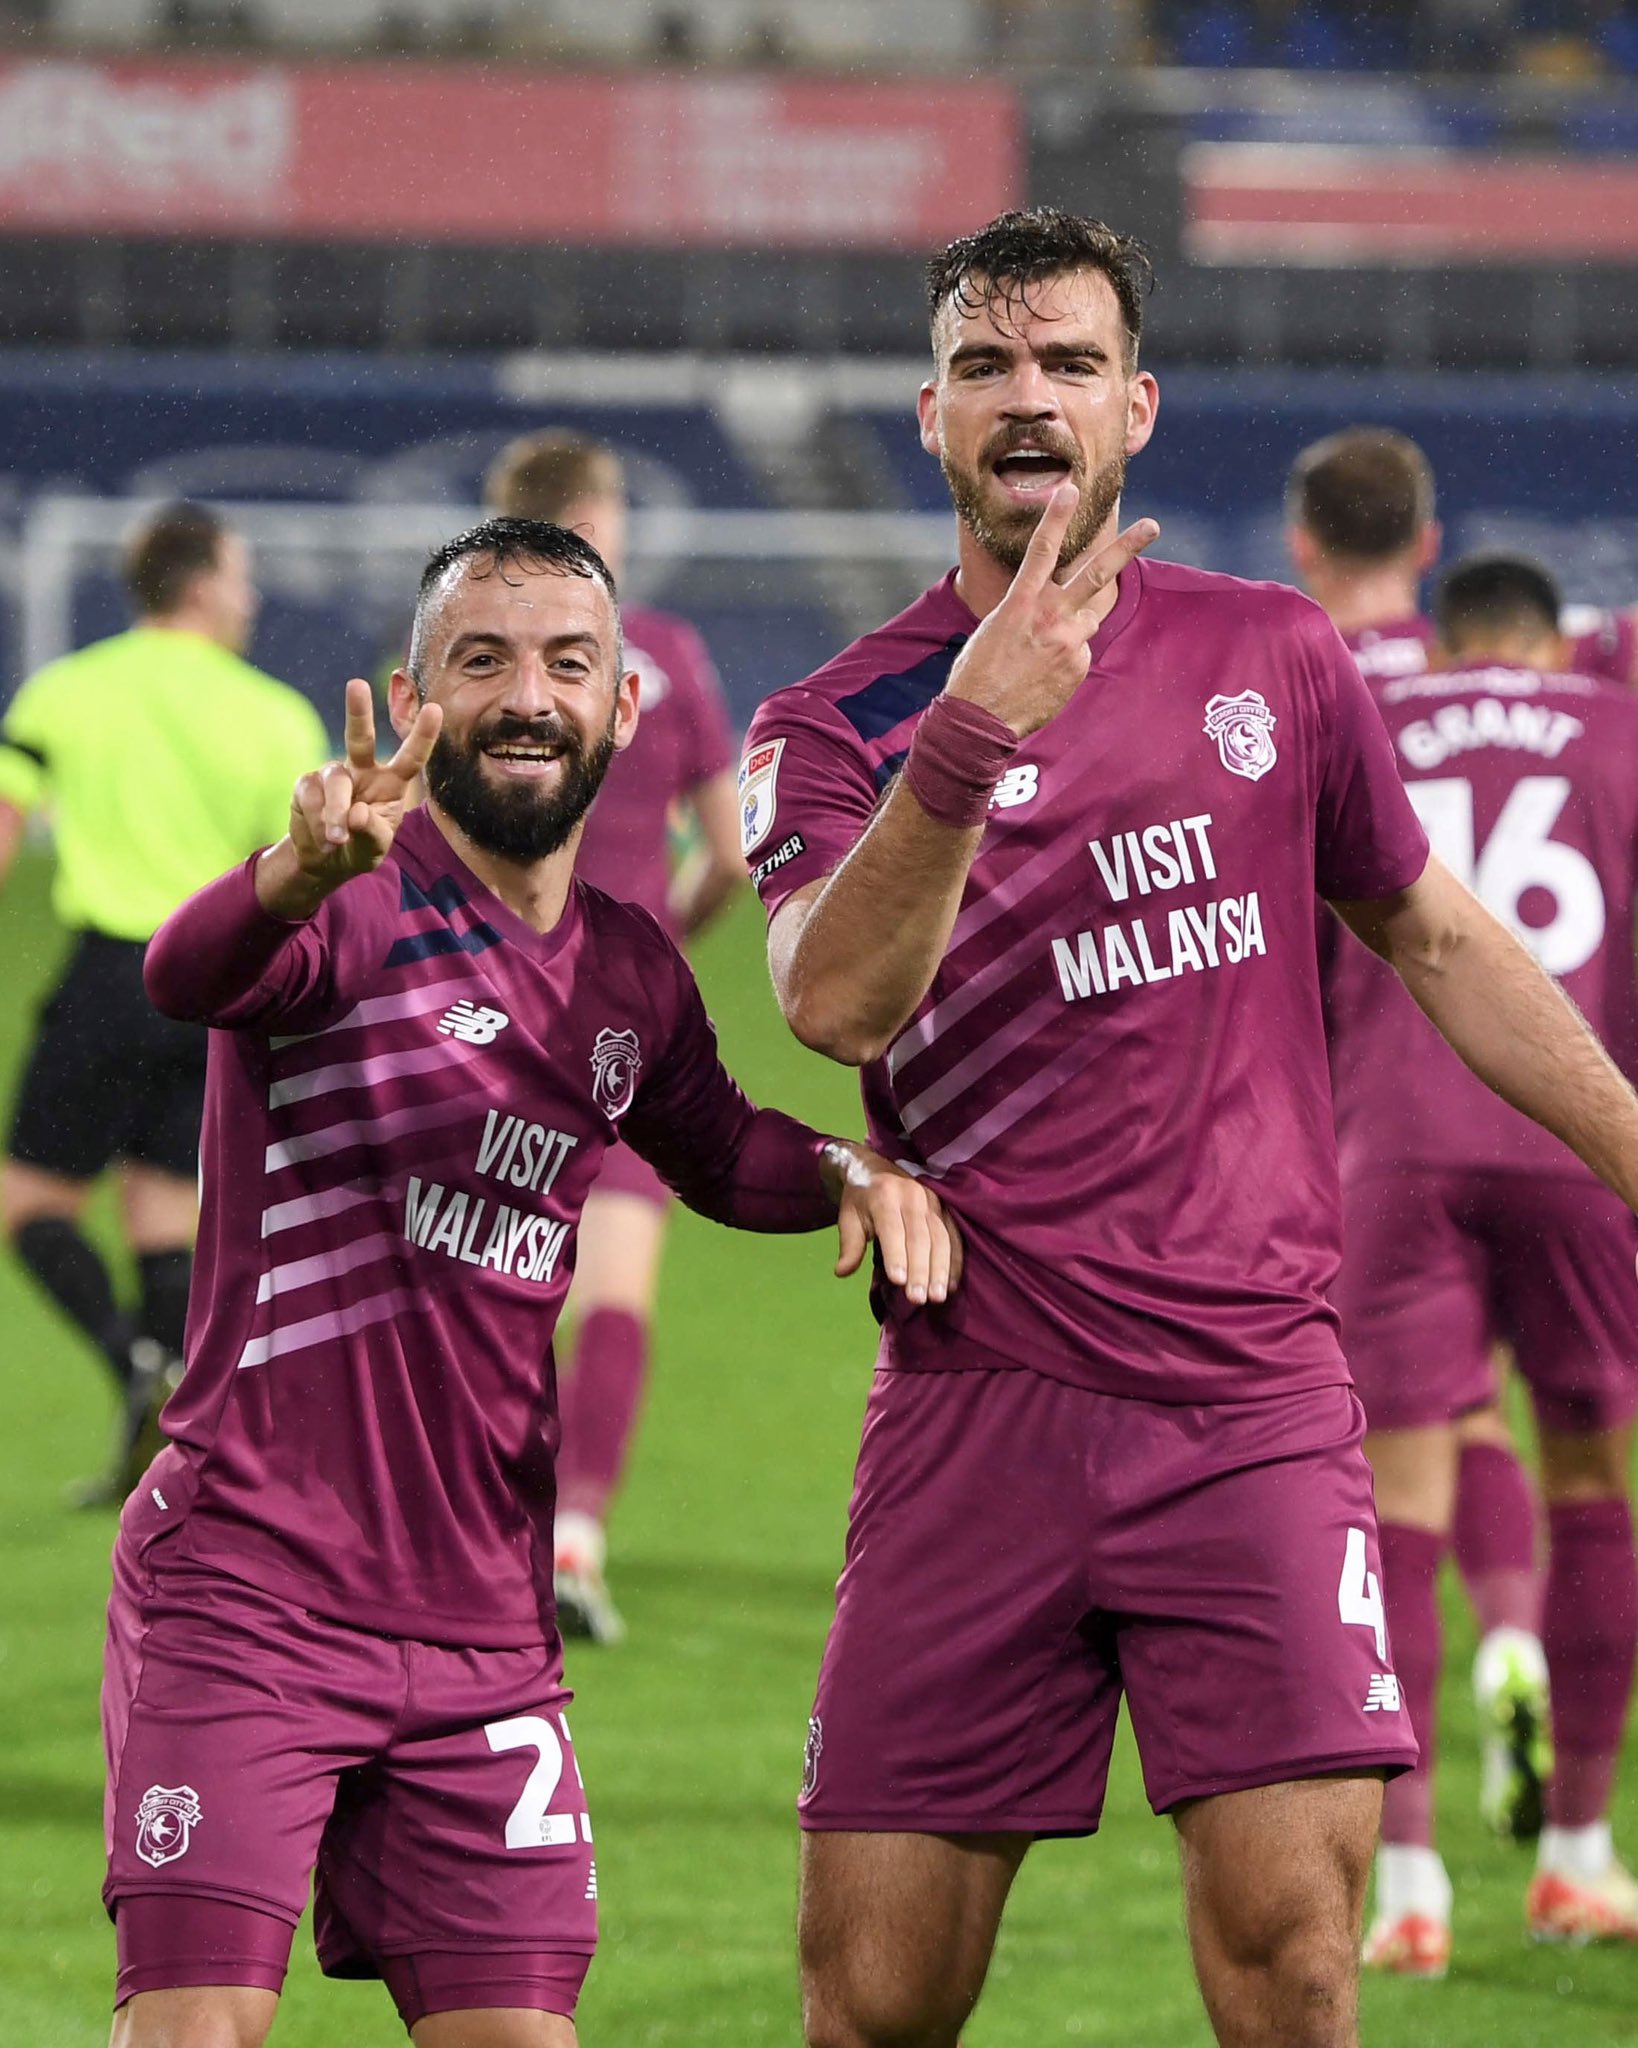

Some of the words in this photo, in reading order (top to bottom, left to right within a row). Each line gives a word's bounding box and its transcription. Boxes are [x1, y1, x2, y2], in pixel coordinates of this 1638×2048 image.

[750, 751, 773, 771] bet
[1400, 698, 1584, 770] GRANT
[1088, 813, 1217, 902] VISIT
[1403, 775, 1606, 976] 16
[436, 998, 510, 1046] NB
[474, 1108, 578, 1196] VISIT
[404, 1175, 572, 1284] MALAYSIA
[1338, 1527, 1387, 1661] 4
